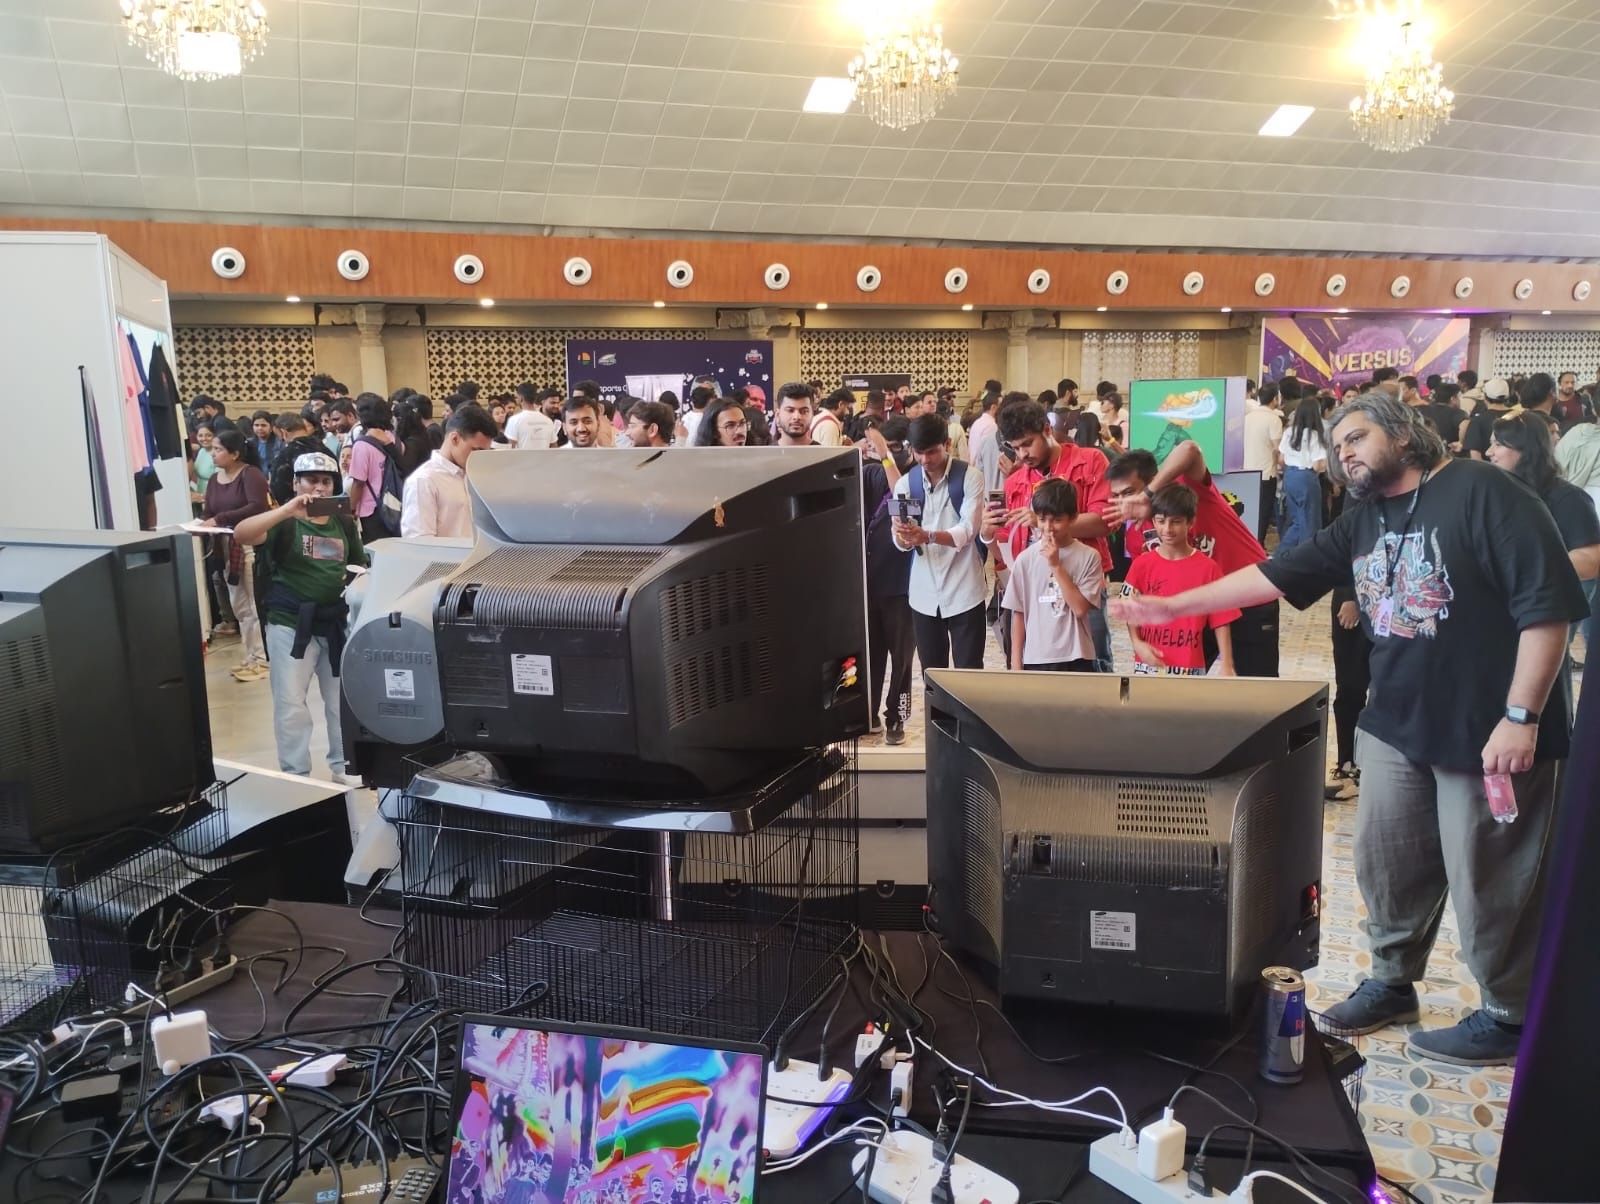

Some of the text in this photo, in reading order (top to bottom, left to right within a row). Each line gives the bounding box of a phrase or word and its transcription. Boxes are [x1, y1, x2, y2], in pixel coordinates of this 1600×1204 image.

[1335, 348, 1412, 372] VERSUS
[363, 649, 432, 665] SAMSUNG
[897, 693, 907, 722] didas
